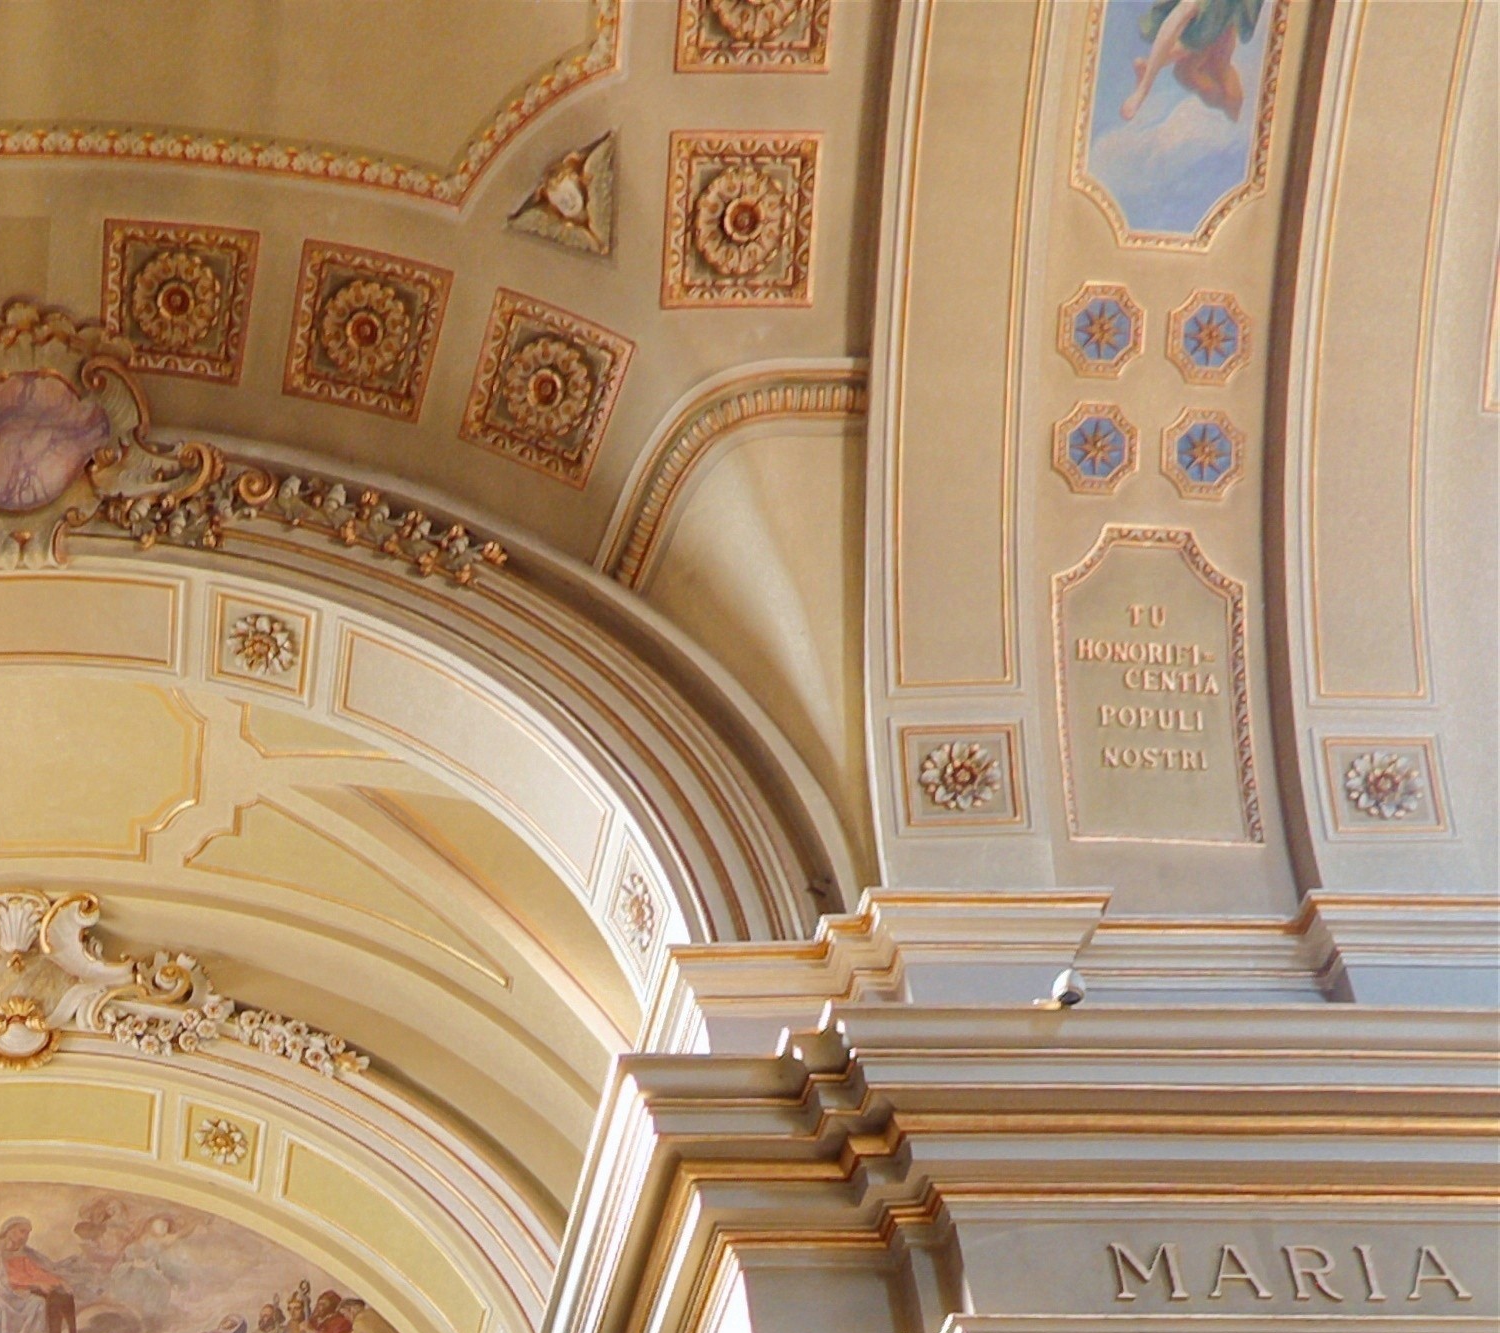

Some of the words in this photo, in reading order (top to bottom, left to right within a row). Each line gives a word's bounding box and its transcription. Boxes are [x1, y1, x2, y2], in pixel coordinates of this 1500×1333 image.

[1128, 604, 1167, 628] TU
[1124, 668, 1220, 695] CENTIA
[1100, 704, 1204, 731] POPULI
[1103, 747, 1209, 770] NOSTRI
[1107, 1241, 1474, 1302] MARIA
